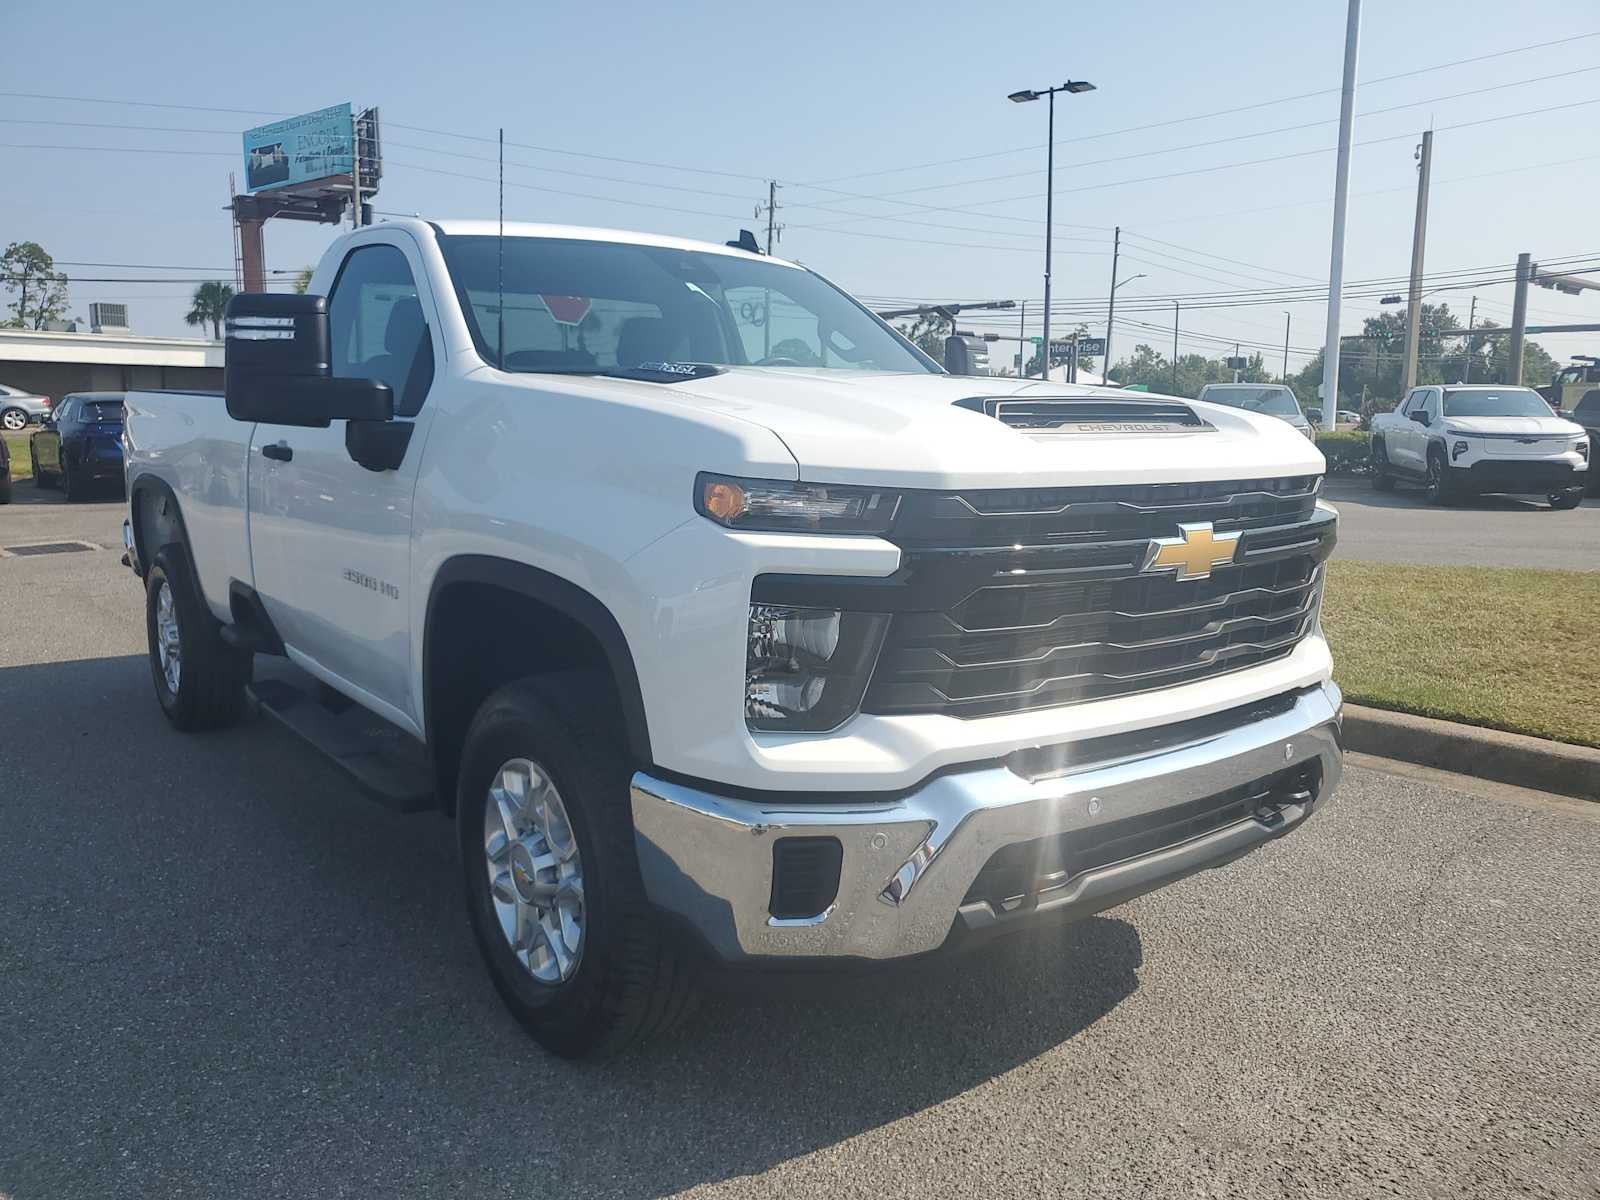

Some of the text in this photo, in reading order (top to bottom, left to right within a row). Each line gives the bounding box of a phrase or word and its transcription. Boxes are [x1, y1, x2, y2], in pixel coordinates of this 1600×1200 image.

[1050, 341, 1100, 354] nterrise
[1077, 423, 1169, 432] CHEVROLET
[380, 579, 400, 600] HD
